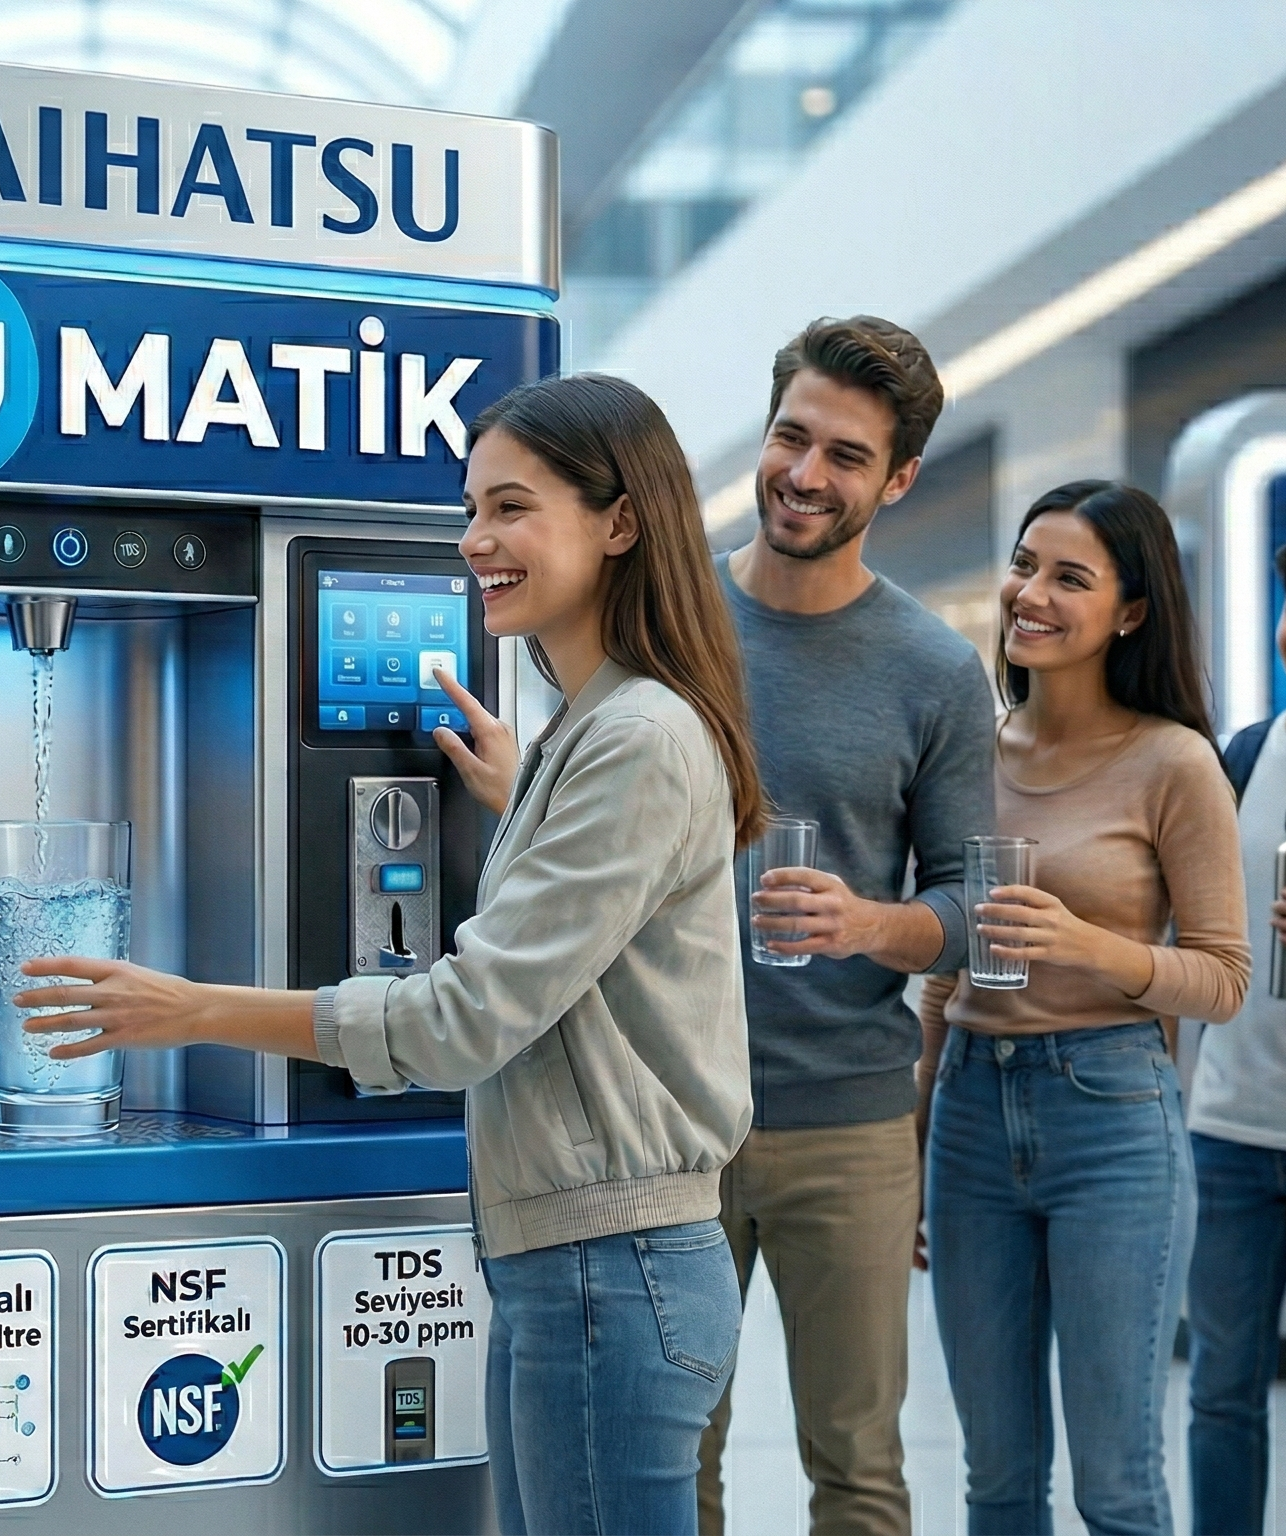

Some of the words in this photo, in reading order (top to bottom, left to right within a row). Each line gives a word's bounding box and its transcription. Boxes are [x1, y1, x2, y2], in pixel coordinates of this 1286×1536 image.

[59, 315, 483, 460] MATİK
[374, 1249, 443, 1281] TDS
[151, 1268, 227, 1303] NSF
[123, 1307, 251, 1339] Sertifikalı
[342, 1320, 410, 1348] 10-30
[417, 1320, 474, 1348] ppm
[397, 1392, 421, 1406] TDS
